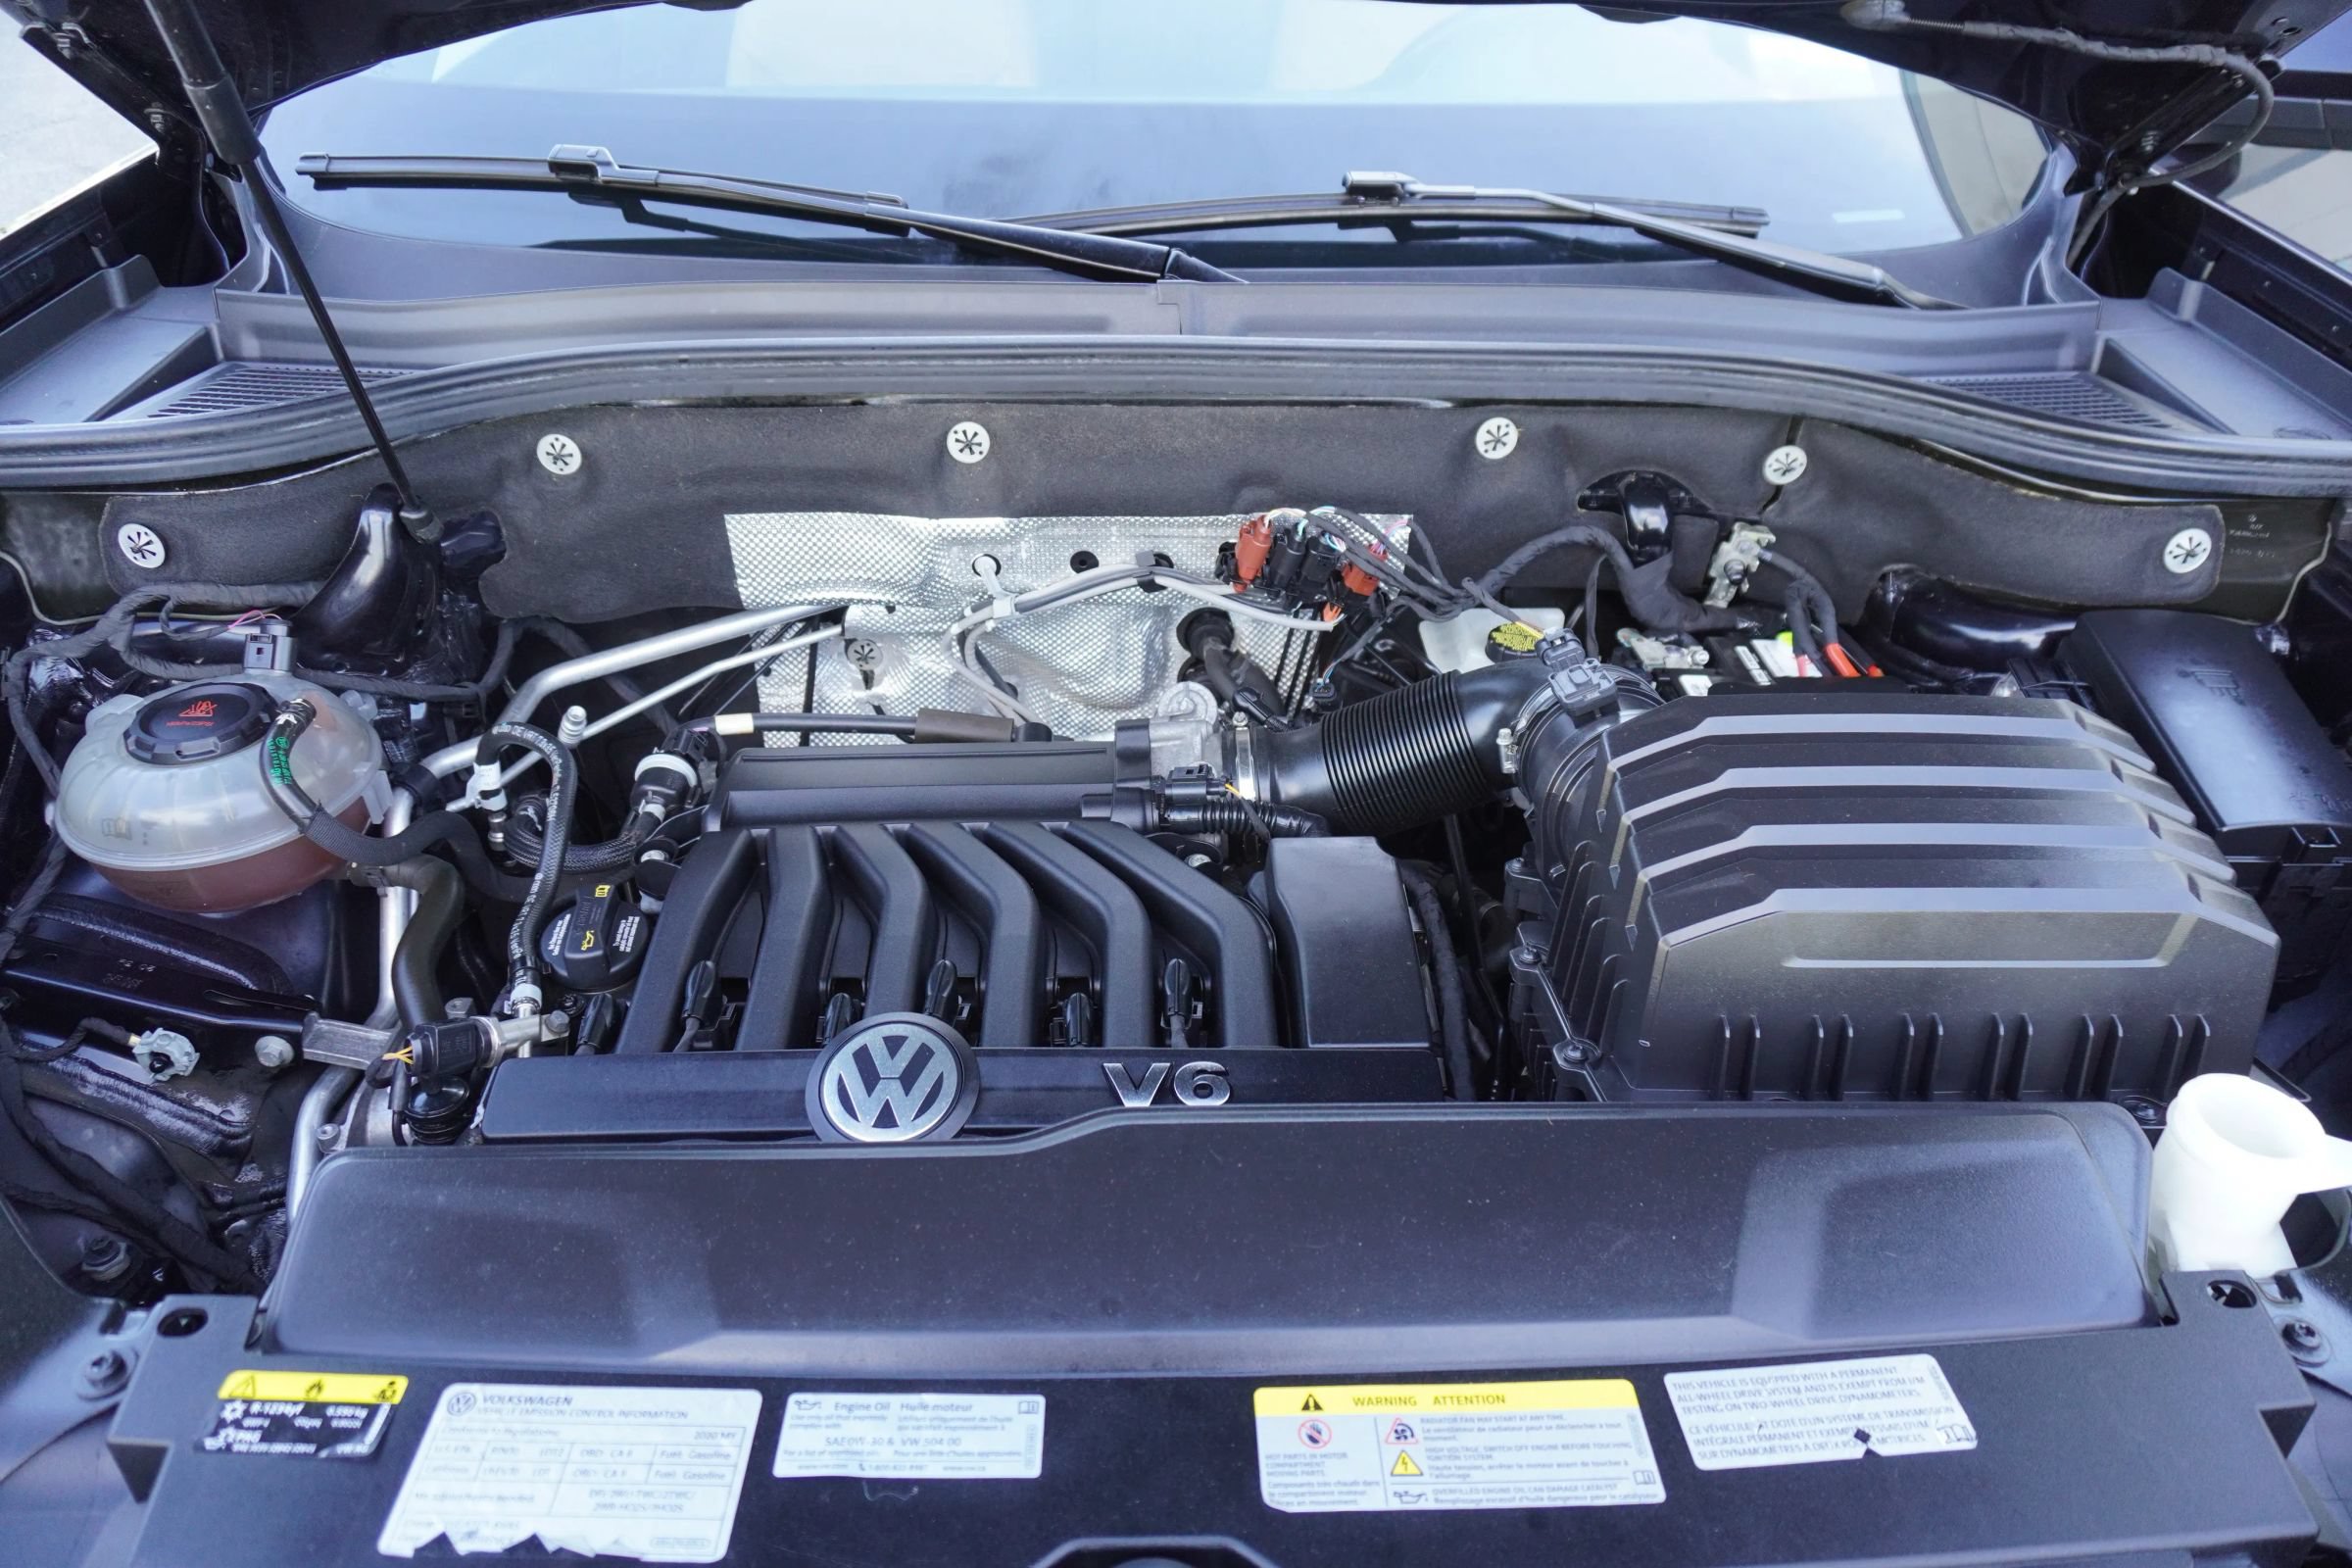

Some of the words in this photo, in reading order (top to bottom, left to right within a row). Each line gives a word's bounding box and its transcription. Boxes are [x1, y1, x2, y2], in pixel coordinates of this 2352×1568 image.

[1102, 1062, 1231, 1108] V6
[1672, 1382, 1696, 1392] THIS
[1696, 1378, 1737, 1391] VEHICLE
[1738, 1378, 1749, 1387] IS
[1800, 1371, 1829, 1383] WITH
[1830, 1371, 1838, 1380] A
[1838, 1365, 1898, 1380] PERMANENT
[1733, 1389, 1764, 1399] DRIVE
[1766, 1385, 1803, 1397] SYSTEM
[1803, 1383, 1828, 1395] AND
[1838, 1379, 1877, 1392] EXEMPT
[1877, 1377, 1908, 1389] FROM
[482, 1395, 573, 1407] VOLKSWAGEN
[1352, 1395, 1417, 1407] WARNING
[1432, 1394, 1506, 1406] ATTENTION
[1681, 1403, 1724, 1417] TESTING
[1724, 1401, 1742, 1412] ON
[1806, 1394, 1837, 1405] DRIVE
[833, 1401, 871, 1414] Engine
[874, 1401, 891, 1412] Oil
[900, 1401, 929, 1412] Huile
[931, 1402, 973, 1412] moteur
[617, 1409, 689, 1420] INFORMATION
[1488, 1424, 1524, 1433] radiateur
[1688, 1425, 1701, 1436] CE
[900, 1437, 921, 1447] VW
[1745, 1431, 1805, 1446] PERMANENT
[688, 1450, 731, 1460] Gasoline
[1308, 1451, 1319, 1460] IN
[1319, 1450, 1348, 1460] MOTOR
[1696, 1450, 1720, 1460] SUR
[682, 1471, 726, 1482] Gasoline
[1300, 1468, 1326, 1477] PARTS
